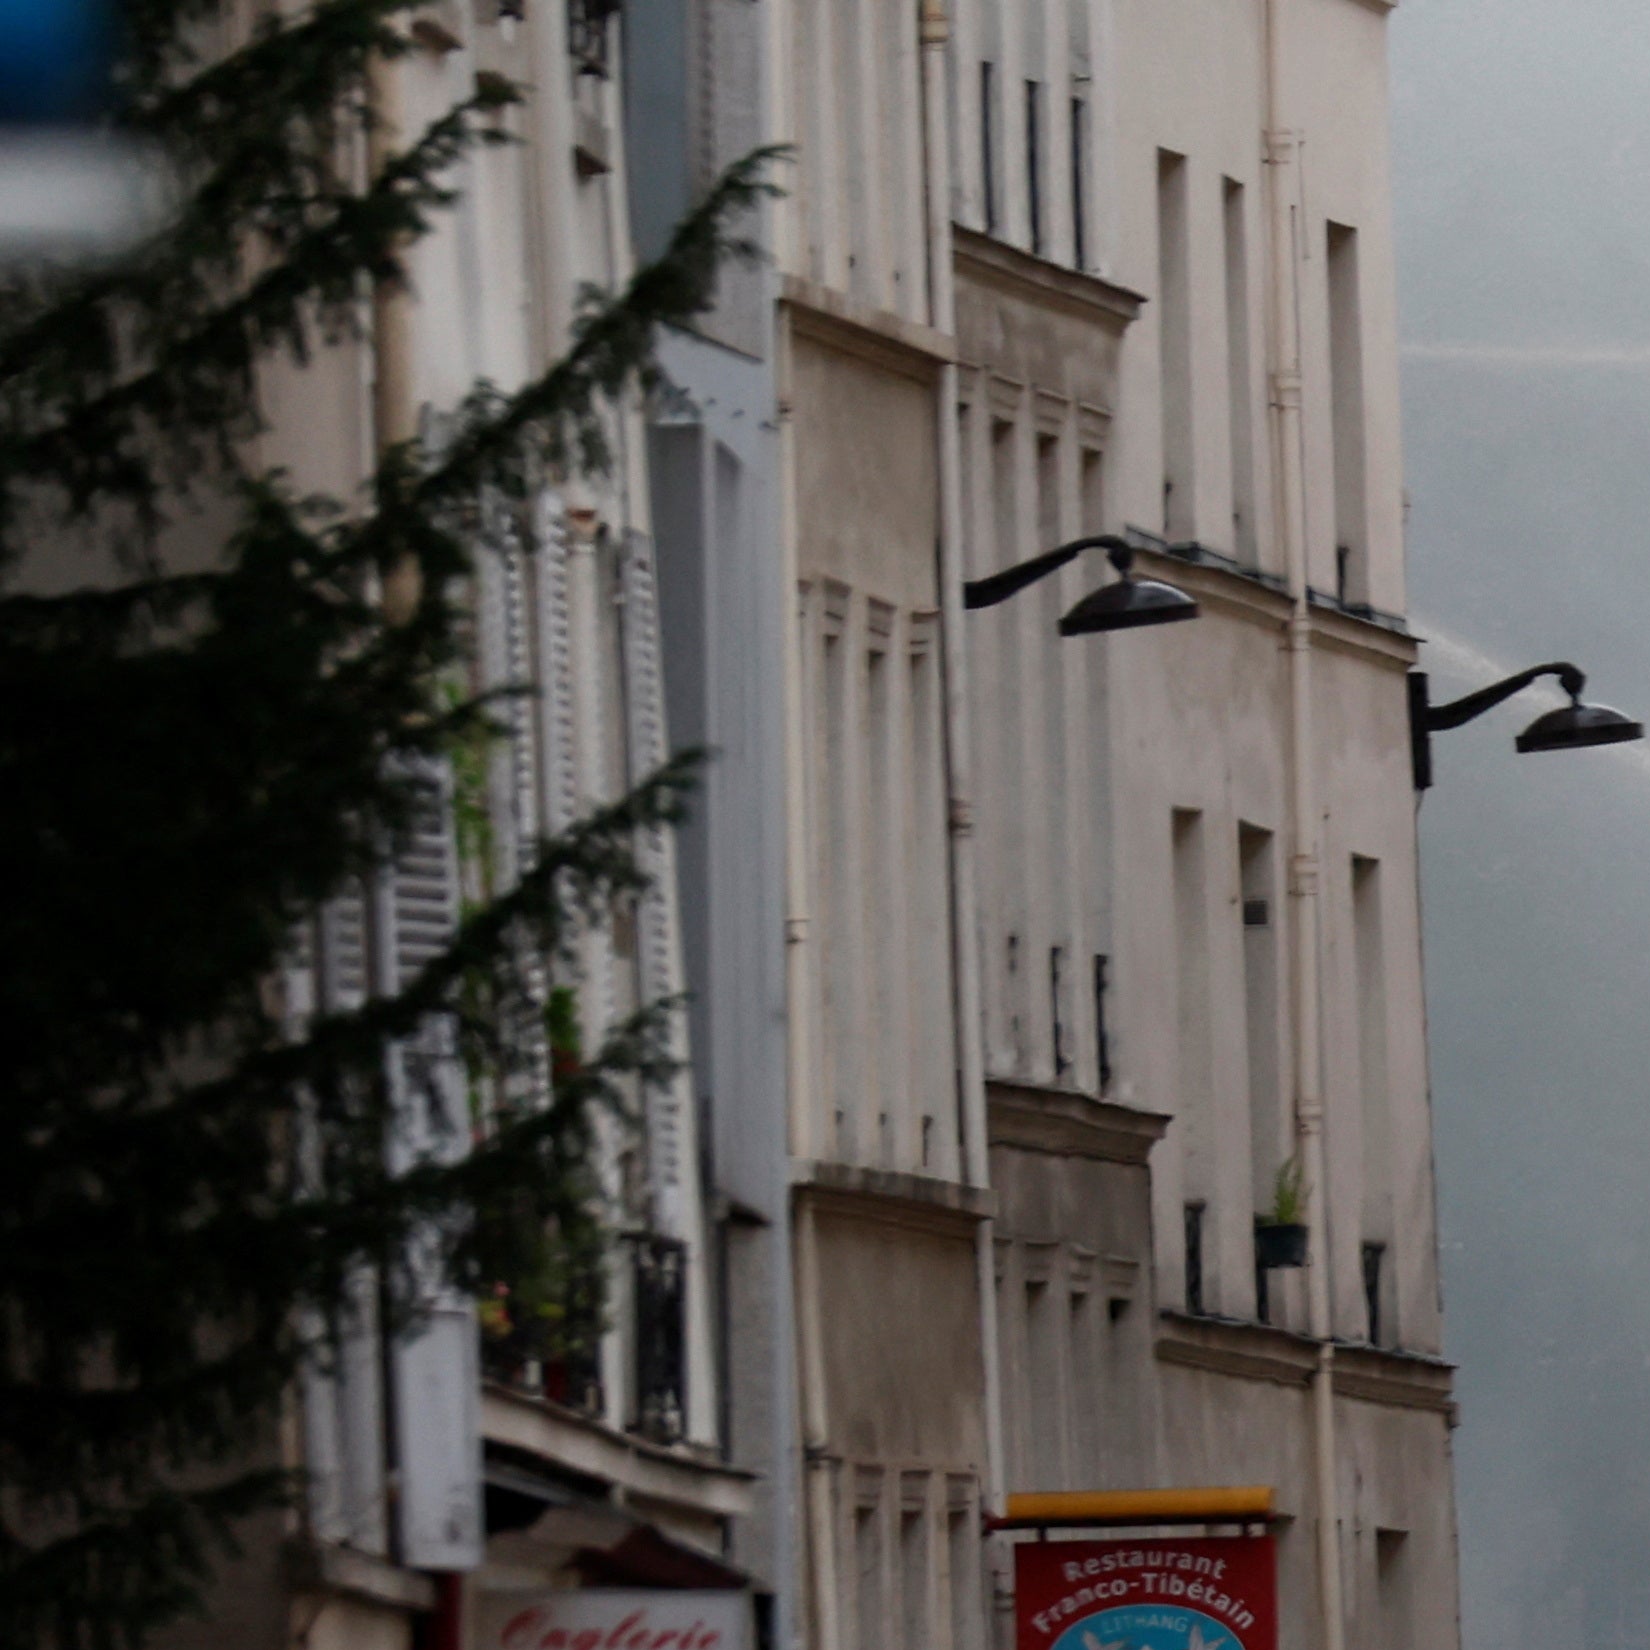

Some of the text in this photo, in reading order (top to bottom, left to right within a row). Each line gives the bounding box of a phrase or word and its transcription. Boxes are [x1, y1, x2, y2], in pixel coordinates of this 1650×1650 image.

[1062, 1549, 1226, 1581] Restaurant
[1032, 1573, 1255, 1634] Franco-Tibétain
[1104, 1612, 1188, 1634] LITHANG
